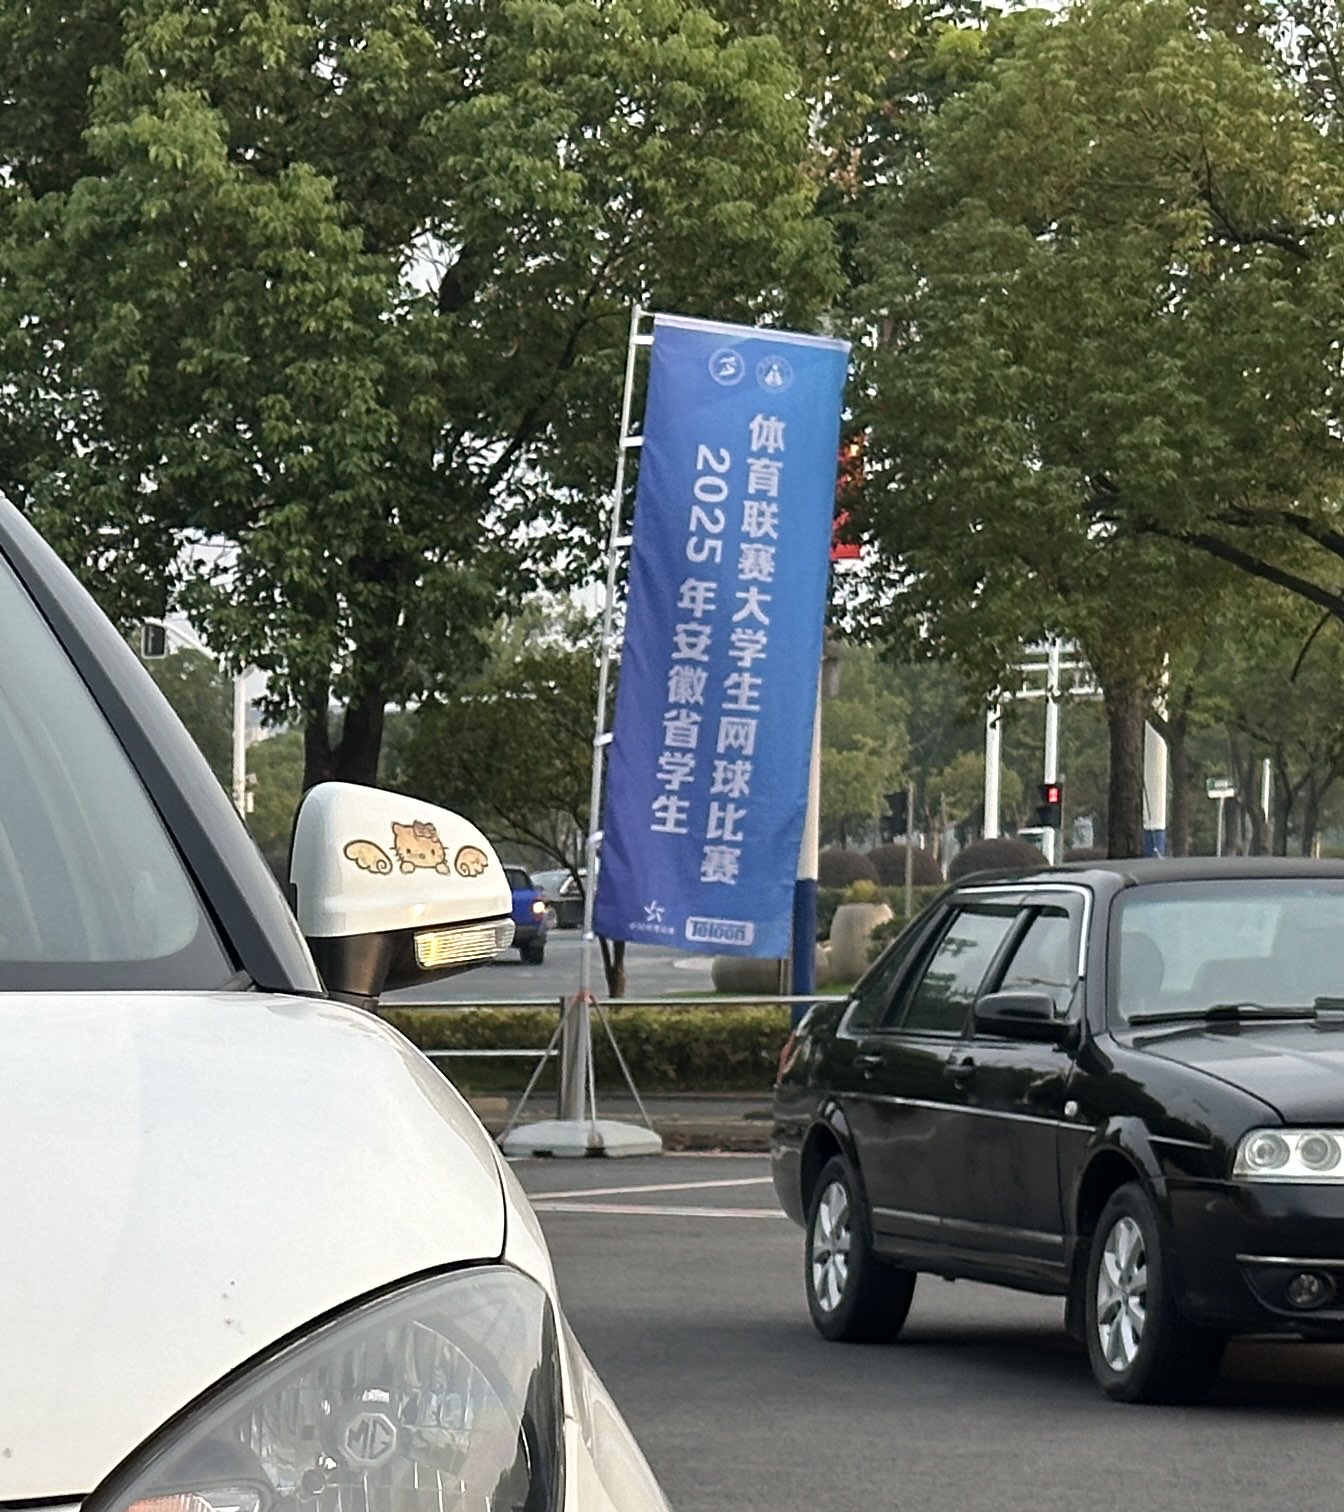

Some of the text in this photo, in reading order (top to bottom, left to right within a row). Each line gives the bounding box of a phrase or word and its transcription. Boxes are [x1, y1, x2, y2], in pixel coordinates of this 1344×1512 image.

[686, 444, 731, 564] 2025
[700, 413, 786, 885] 体育联赛大学生网球比赛
[347, 1419, 392, 1460] MG
